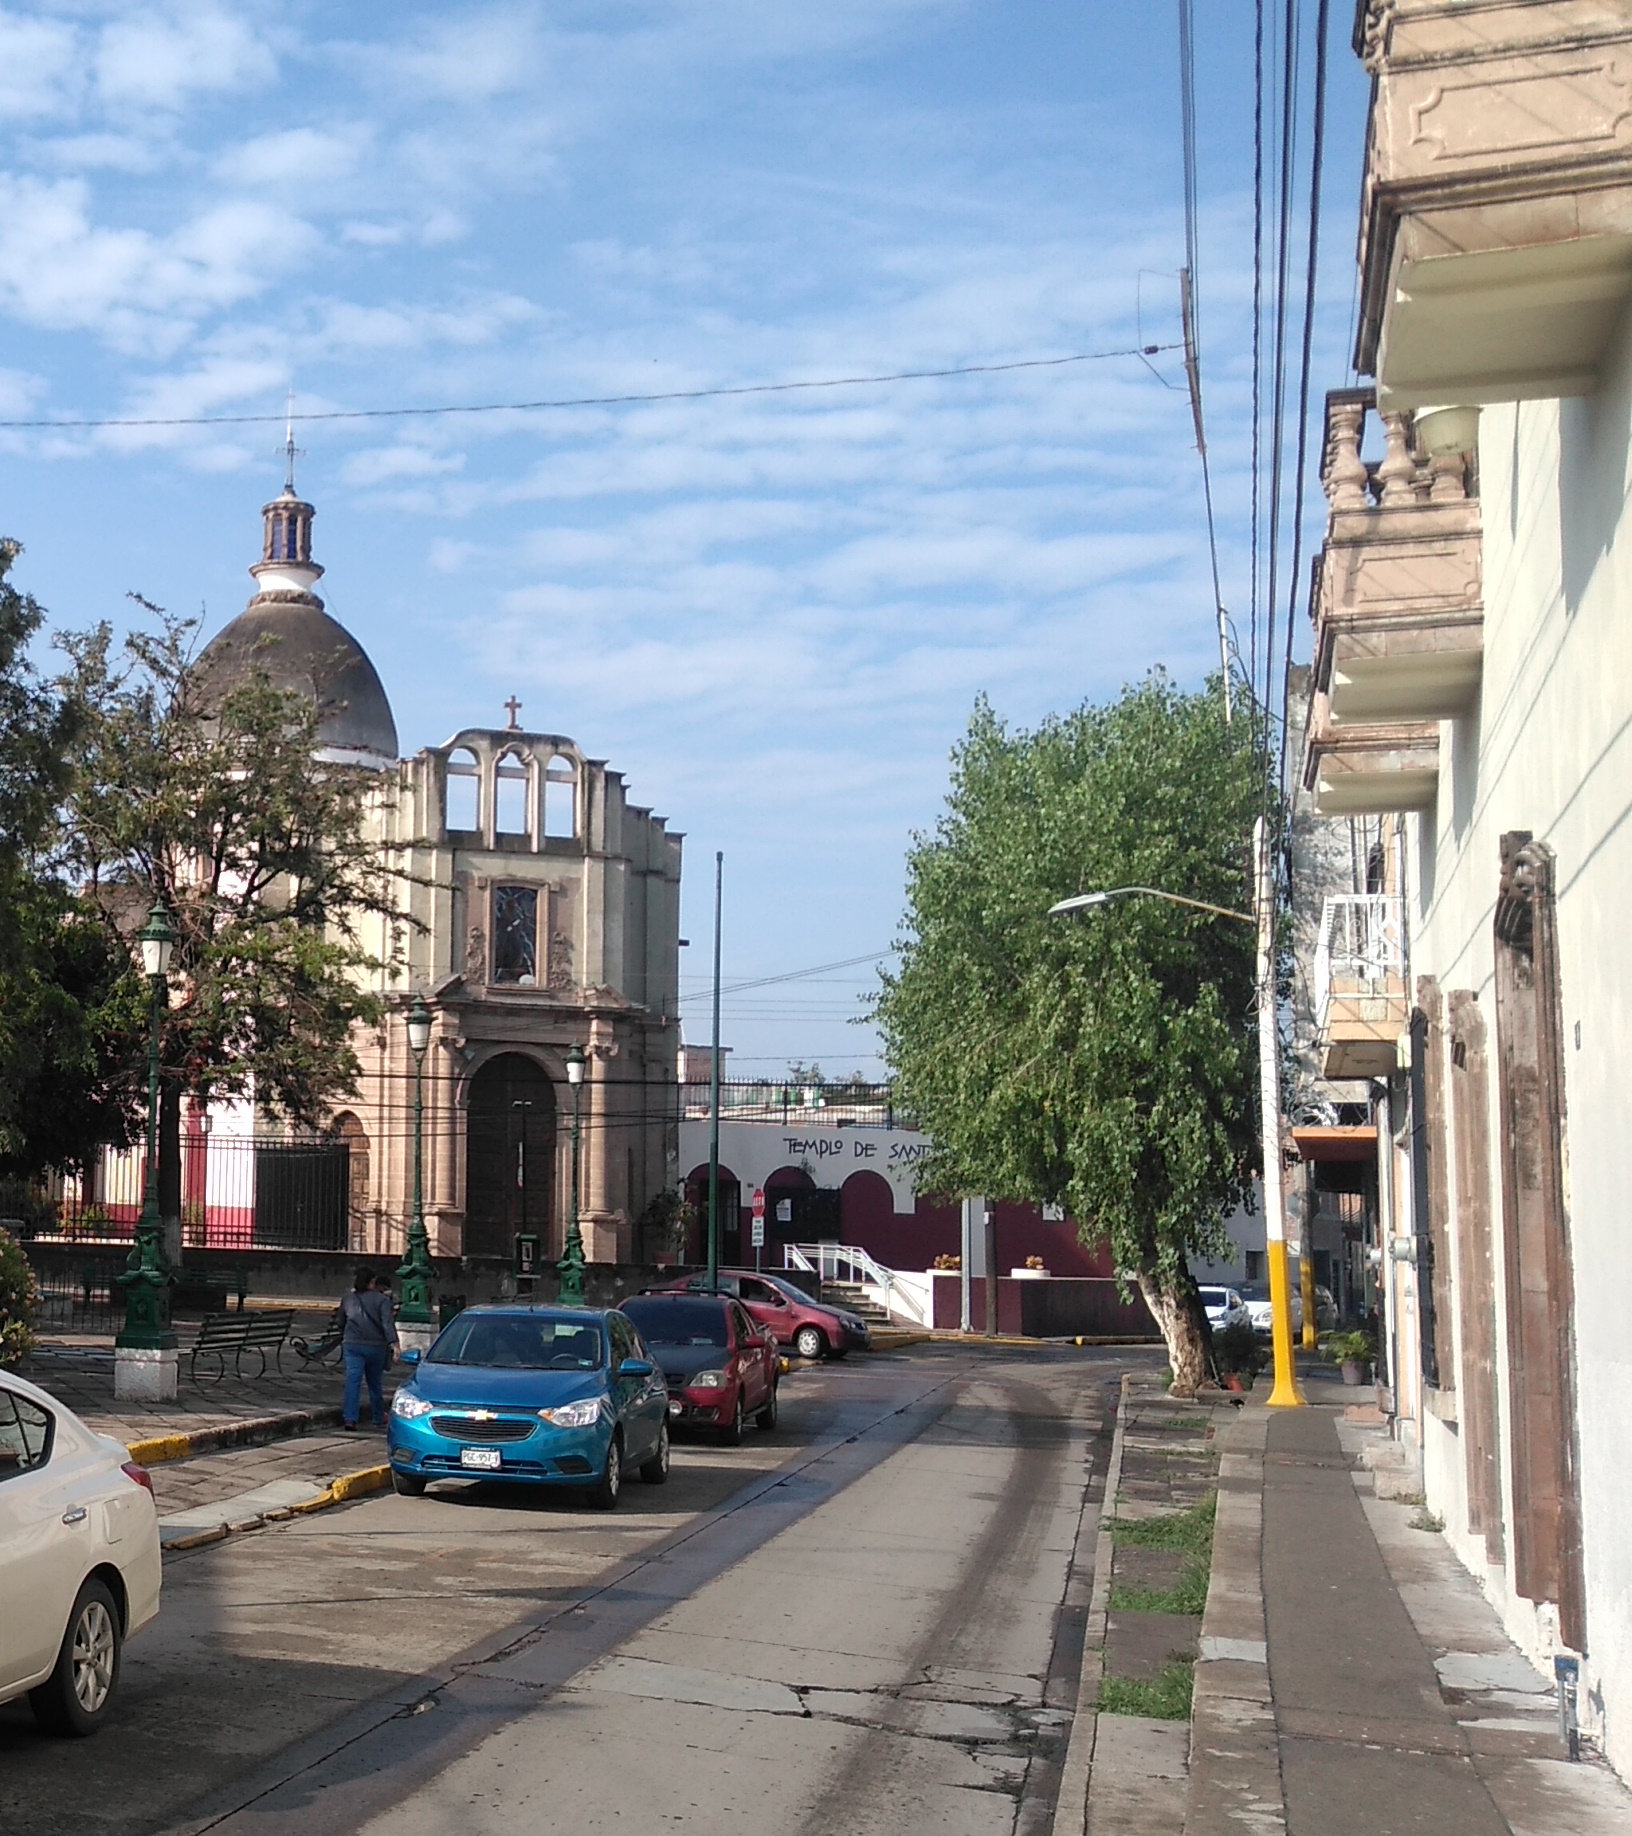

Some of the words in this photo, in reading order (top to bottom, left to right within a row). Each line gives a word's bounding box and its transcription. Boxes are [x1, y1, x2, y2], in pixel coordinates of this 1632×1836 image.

[782, 1138, 843, 1159] TEMPLO
[854, 1141, 877, 1158] DE
[888, 1143, 934, 1159] SANT
